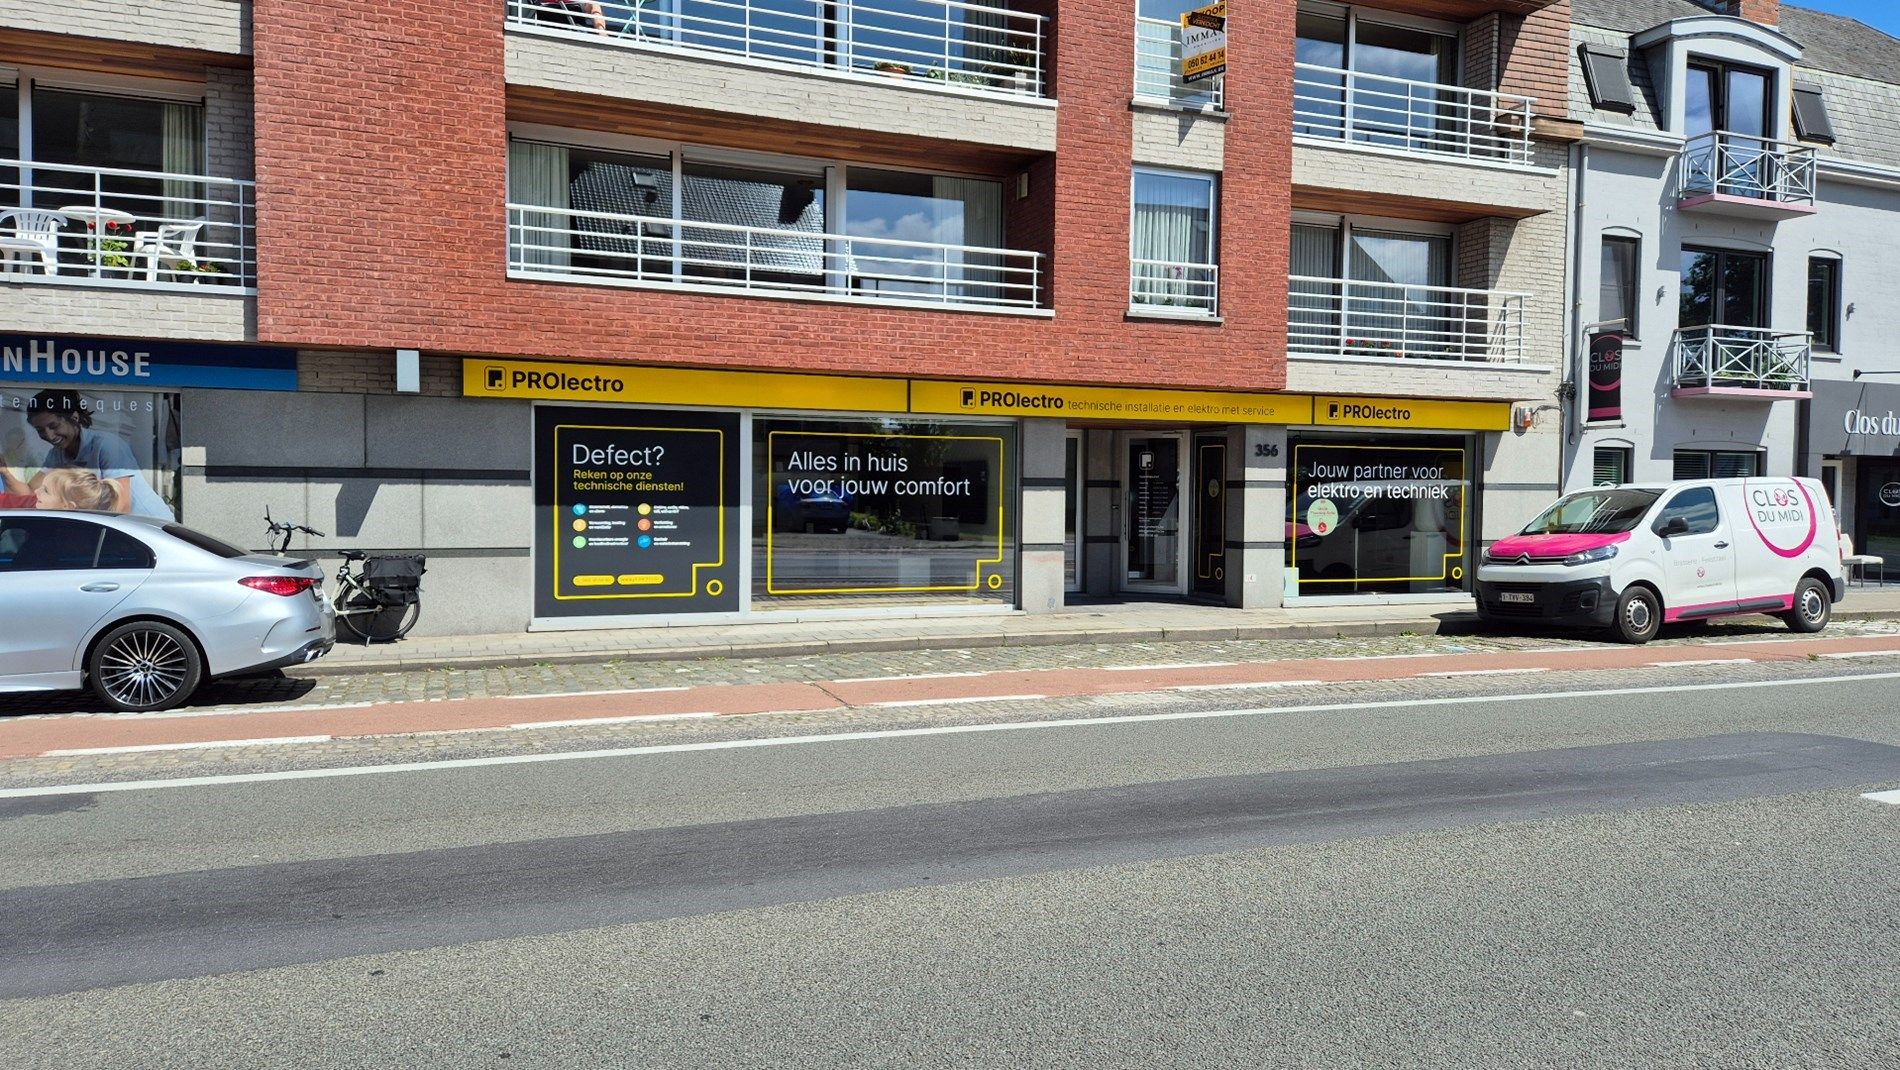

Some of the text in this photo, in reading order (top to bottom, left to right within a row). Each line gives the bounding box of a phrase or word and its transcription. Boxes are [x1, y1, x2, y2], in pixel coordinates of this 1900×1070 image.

[1209, 53, 1217, 61] 44
[1217, 51, 1224, 59] 14
[1590, 350, 1622, 363] CLOS
[1589, 363, 1602, 372] DU
[512, 370, 624, 393] PROlectro
[980, 391, 1275, 416] PROlectro technische installatie en elektro met service
[1343, 404, 1411, 420] PROlectro
[1844, 409, 1900, 436] Clos du
[572, 443, 665, 466] Defect?
[1254, 444, 1279, 457] 356
[788, 451, 909, 473] Alles in huis
[573, 469, 653, 481] Reken op onze
[1308, 461, 1444, 482] Jouw partner voor
[573, 480, 684, 492] technische diensten!
[788, 475, 971, 499] voor jouw comfort
[1307, 482, 1449, 499] elektro en techniek
[1752, 487, 1799, 507] CLOS
[1757, 510, 1804, 523] DU MIDI
